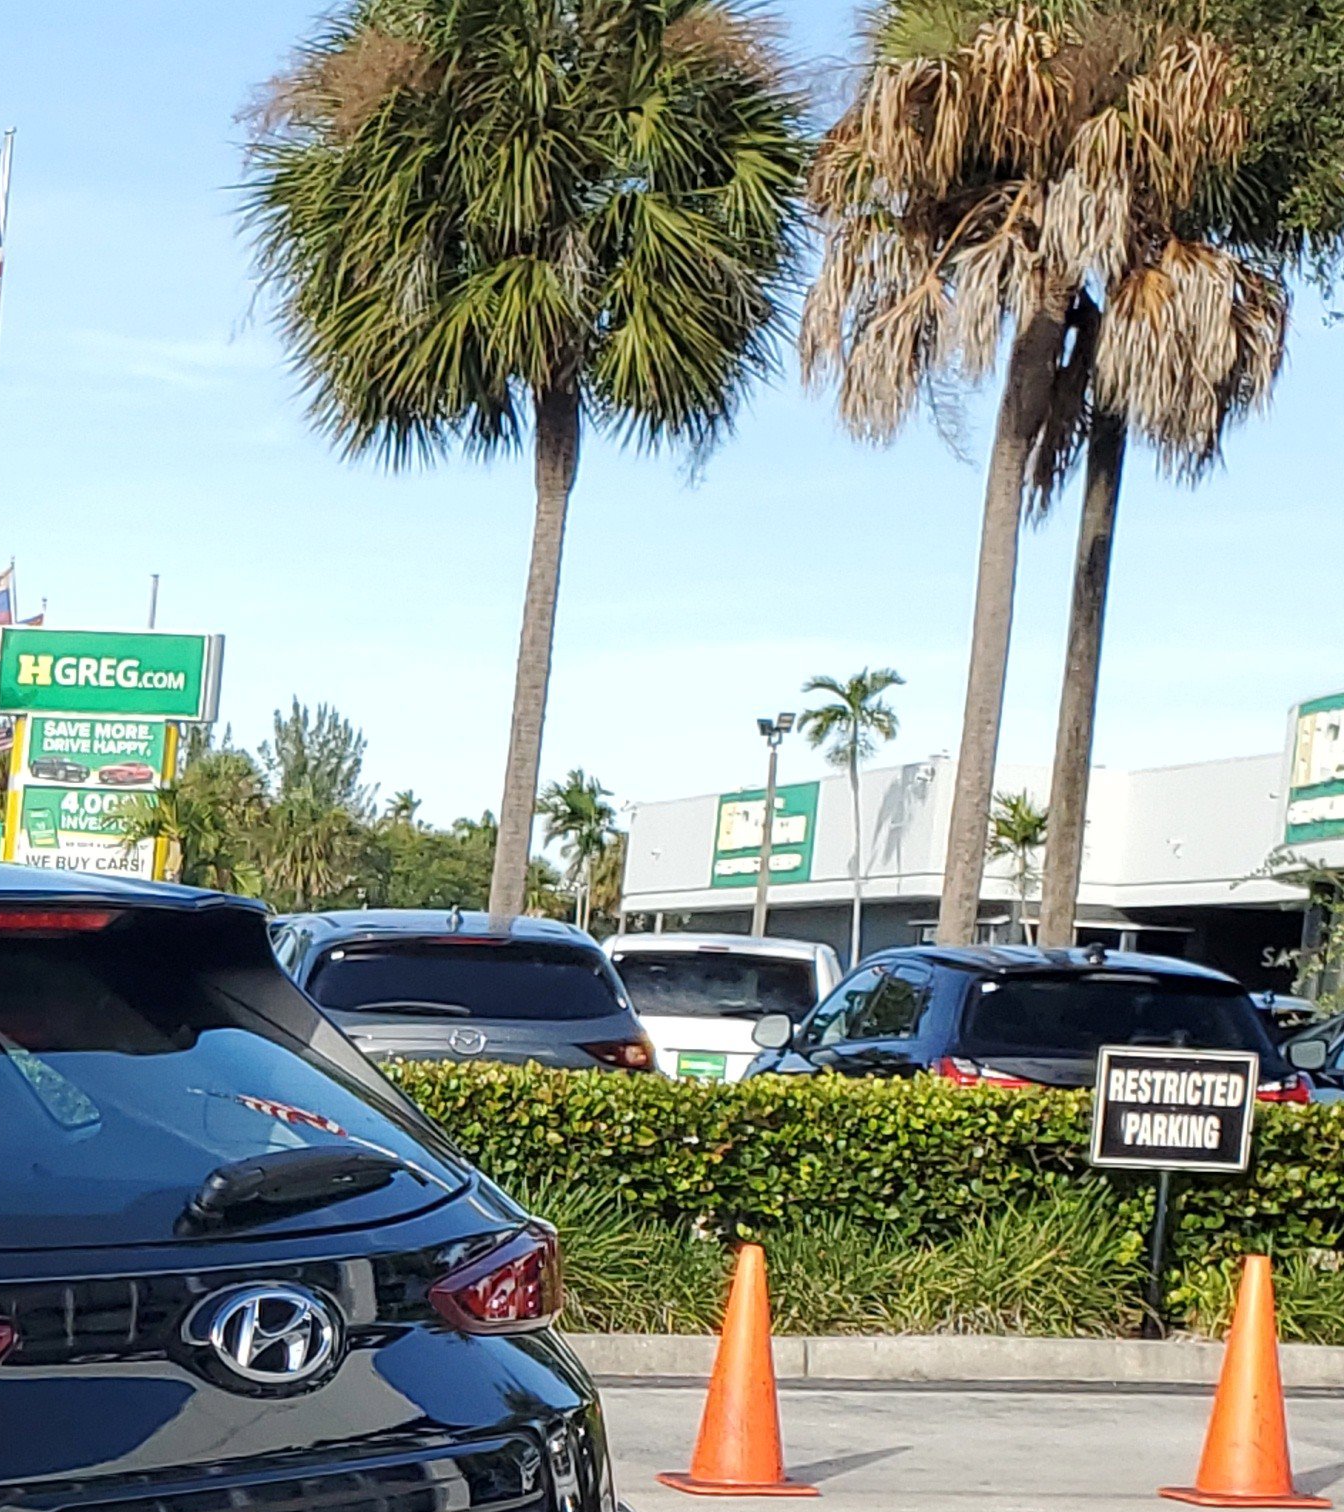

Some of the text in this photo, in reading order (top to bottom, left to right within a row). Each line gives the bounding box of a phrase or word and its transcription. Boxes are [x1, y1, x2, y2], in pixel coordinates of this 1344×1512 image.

[43, 721, 91, 738] SAVE
[42, 737, 91, 753] DRIVE
[26, 854, 51, 869] WE
[56, 856, 91, 872] BUY
[1109, 1068, 1245, 1108] RESTRICTED
[1121, 1111, 1221, 1150] PARKING
